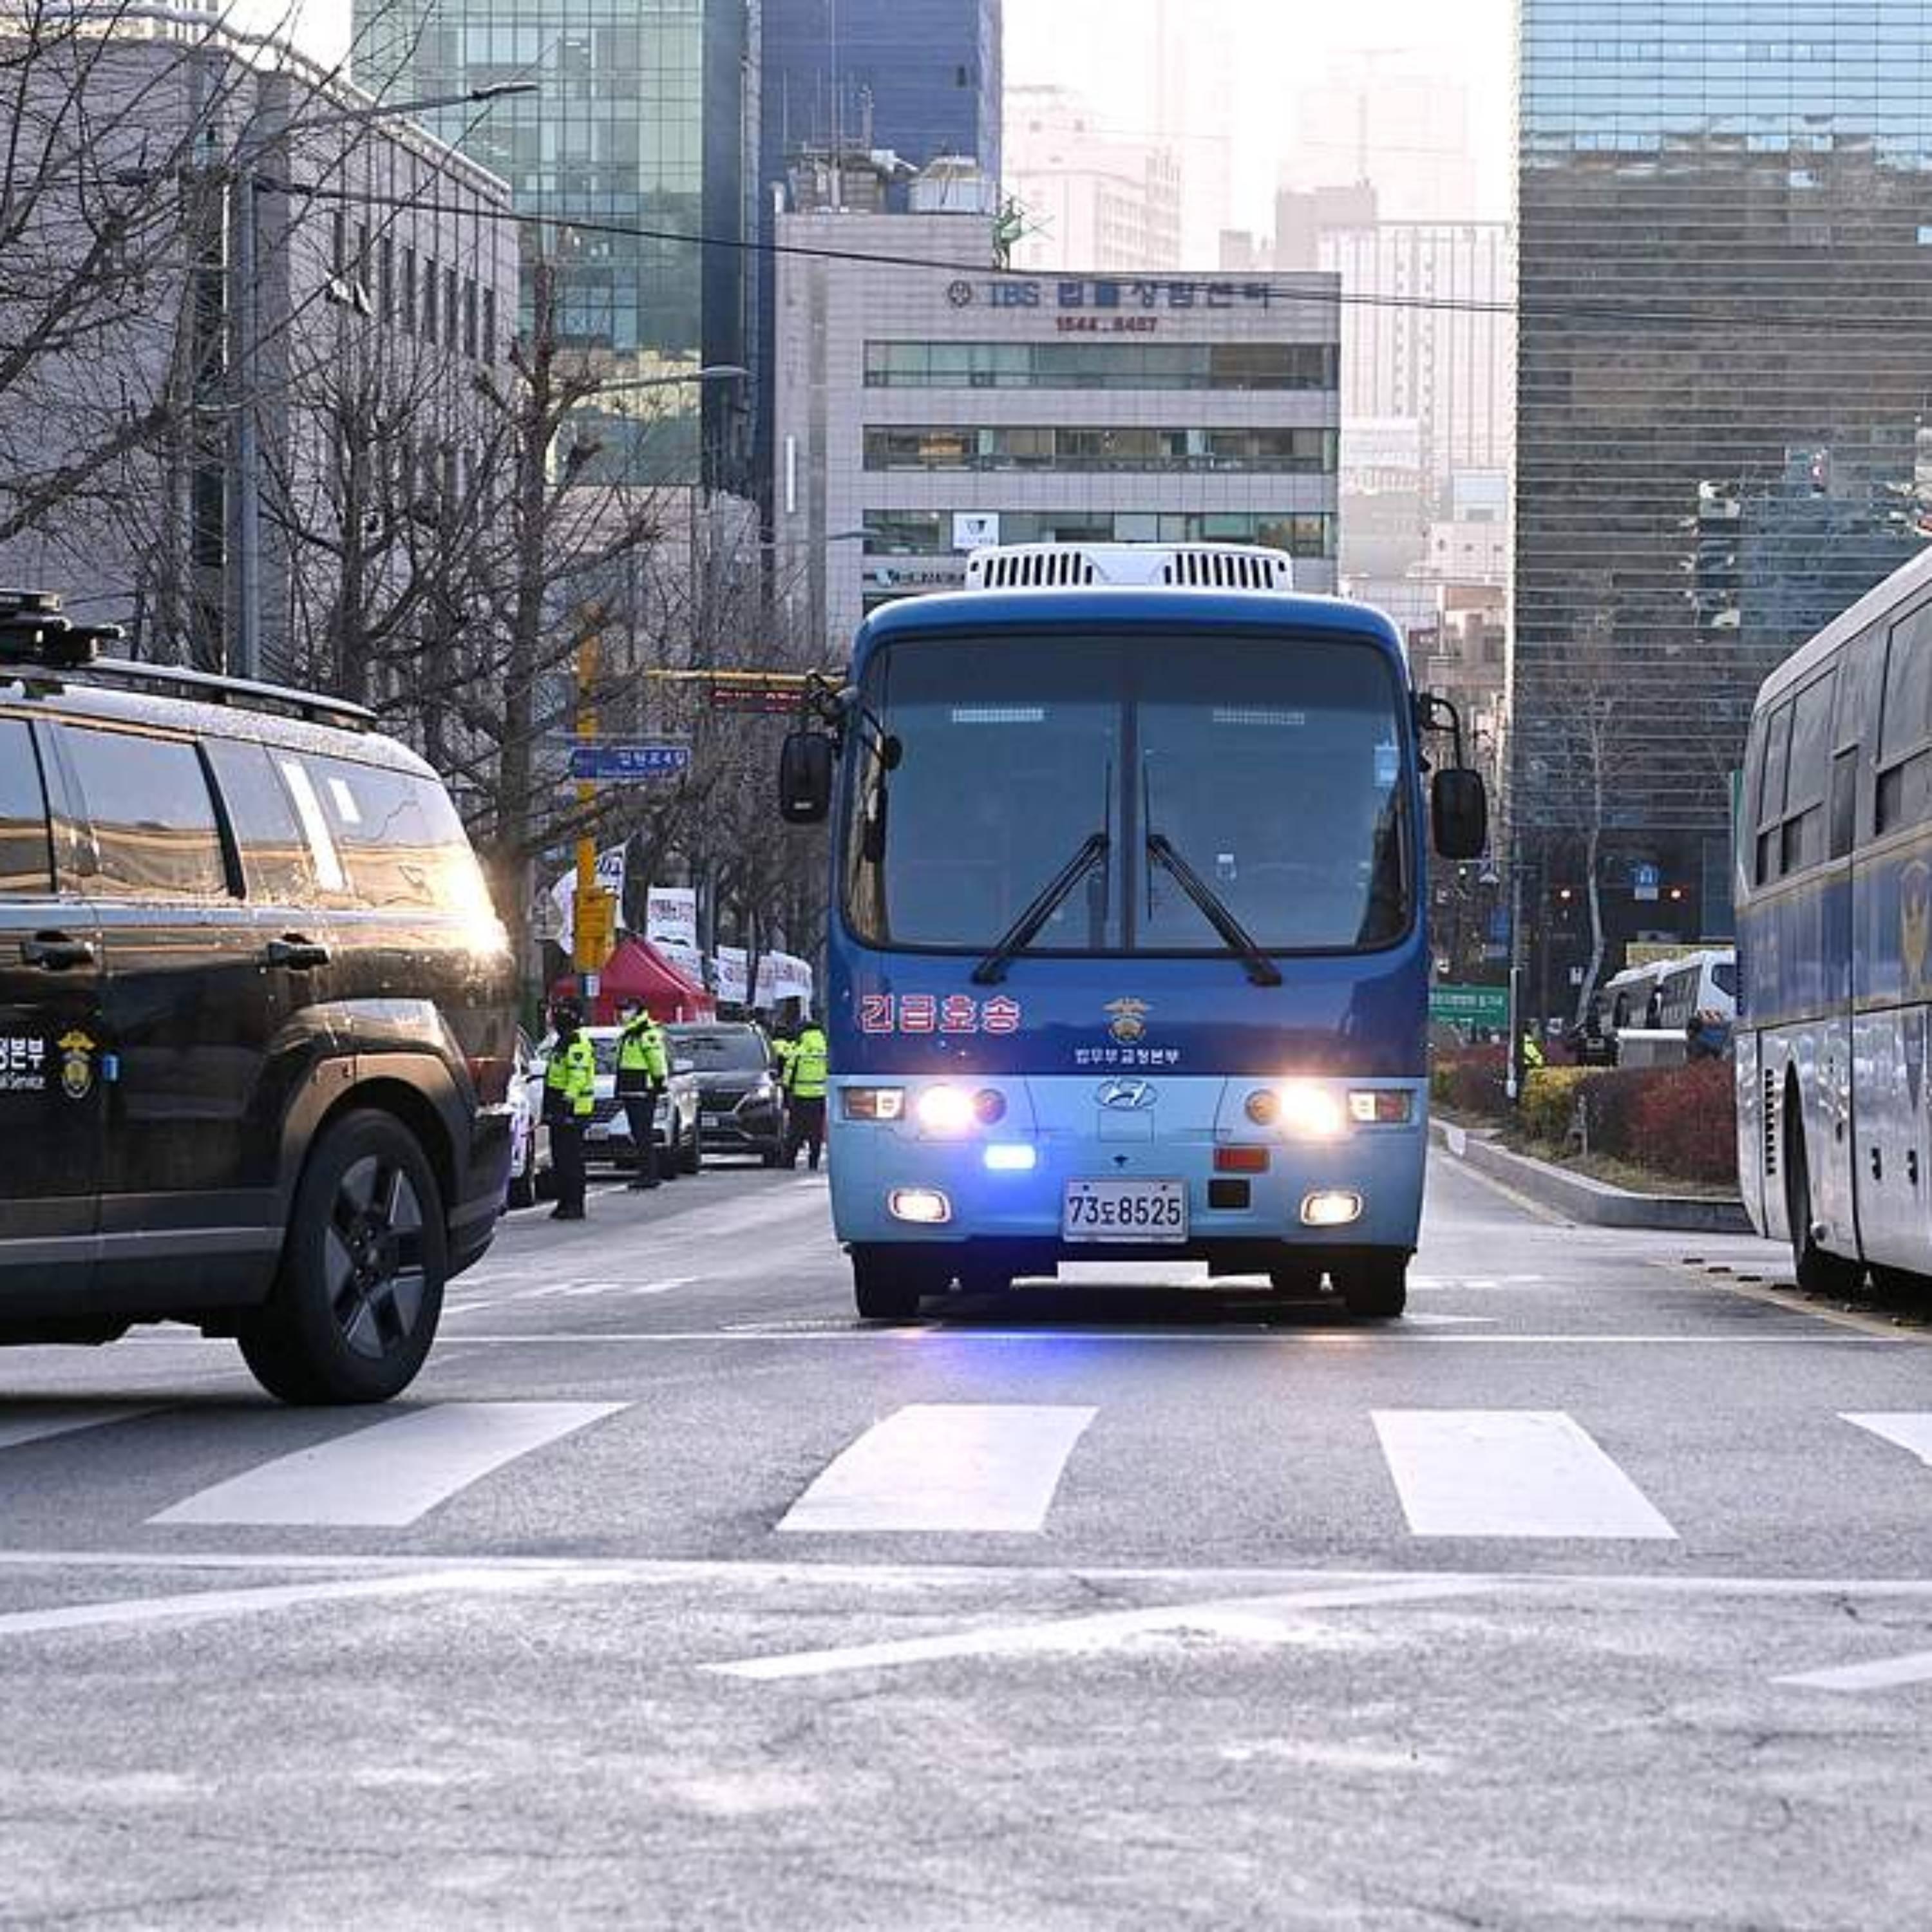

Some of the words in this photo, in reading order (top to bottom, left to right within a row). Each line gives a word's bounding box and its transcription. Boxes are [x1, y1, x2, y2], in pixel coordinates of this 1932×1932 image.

[990, 282, 1039, 308] IBS
[860, 994, 1021, 1034] 긴급호송
[1068, 1196, 1180, 1225] 73도8525
